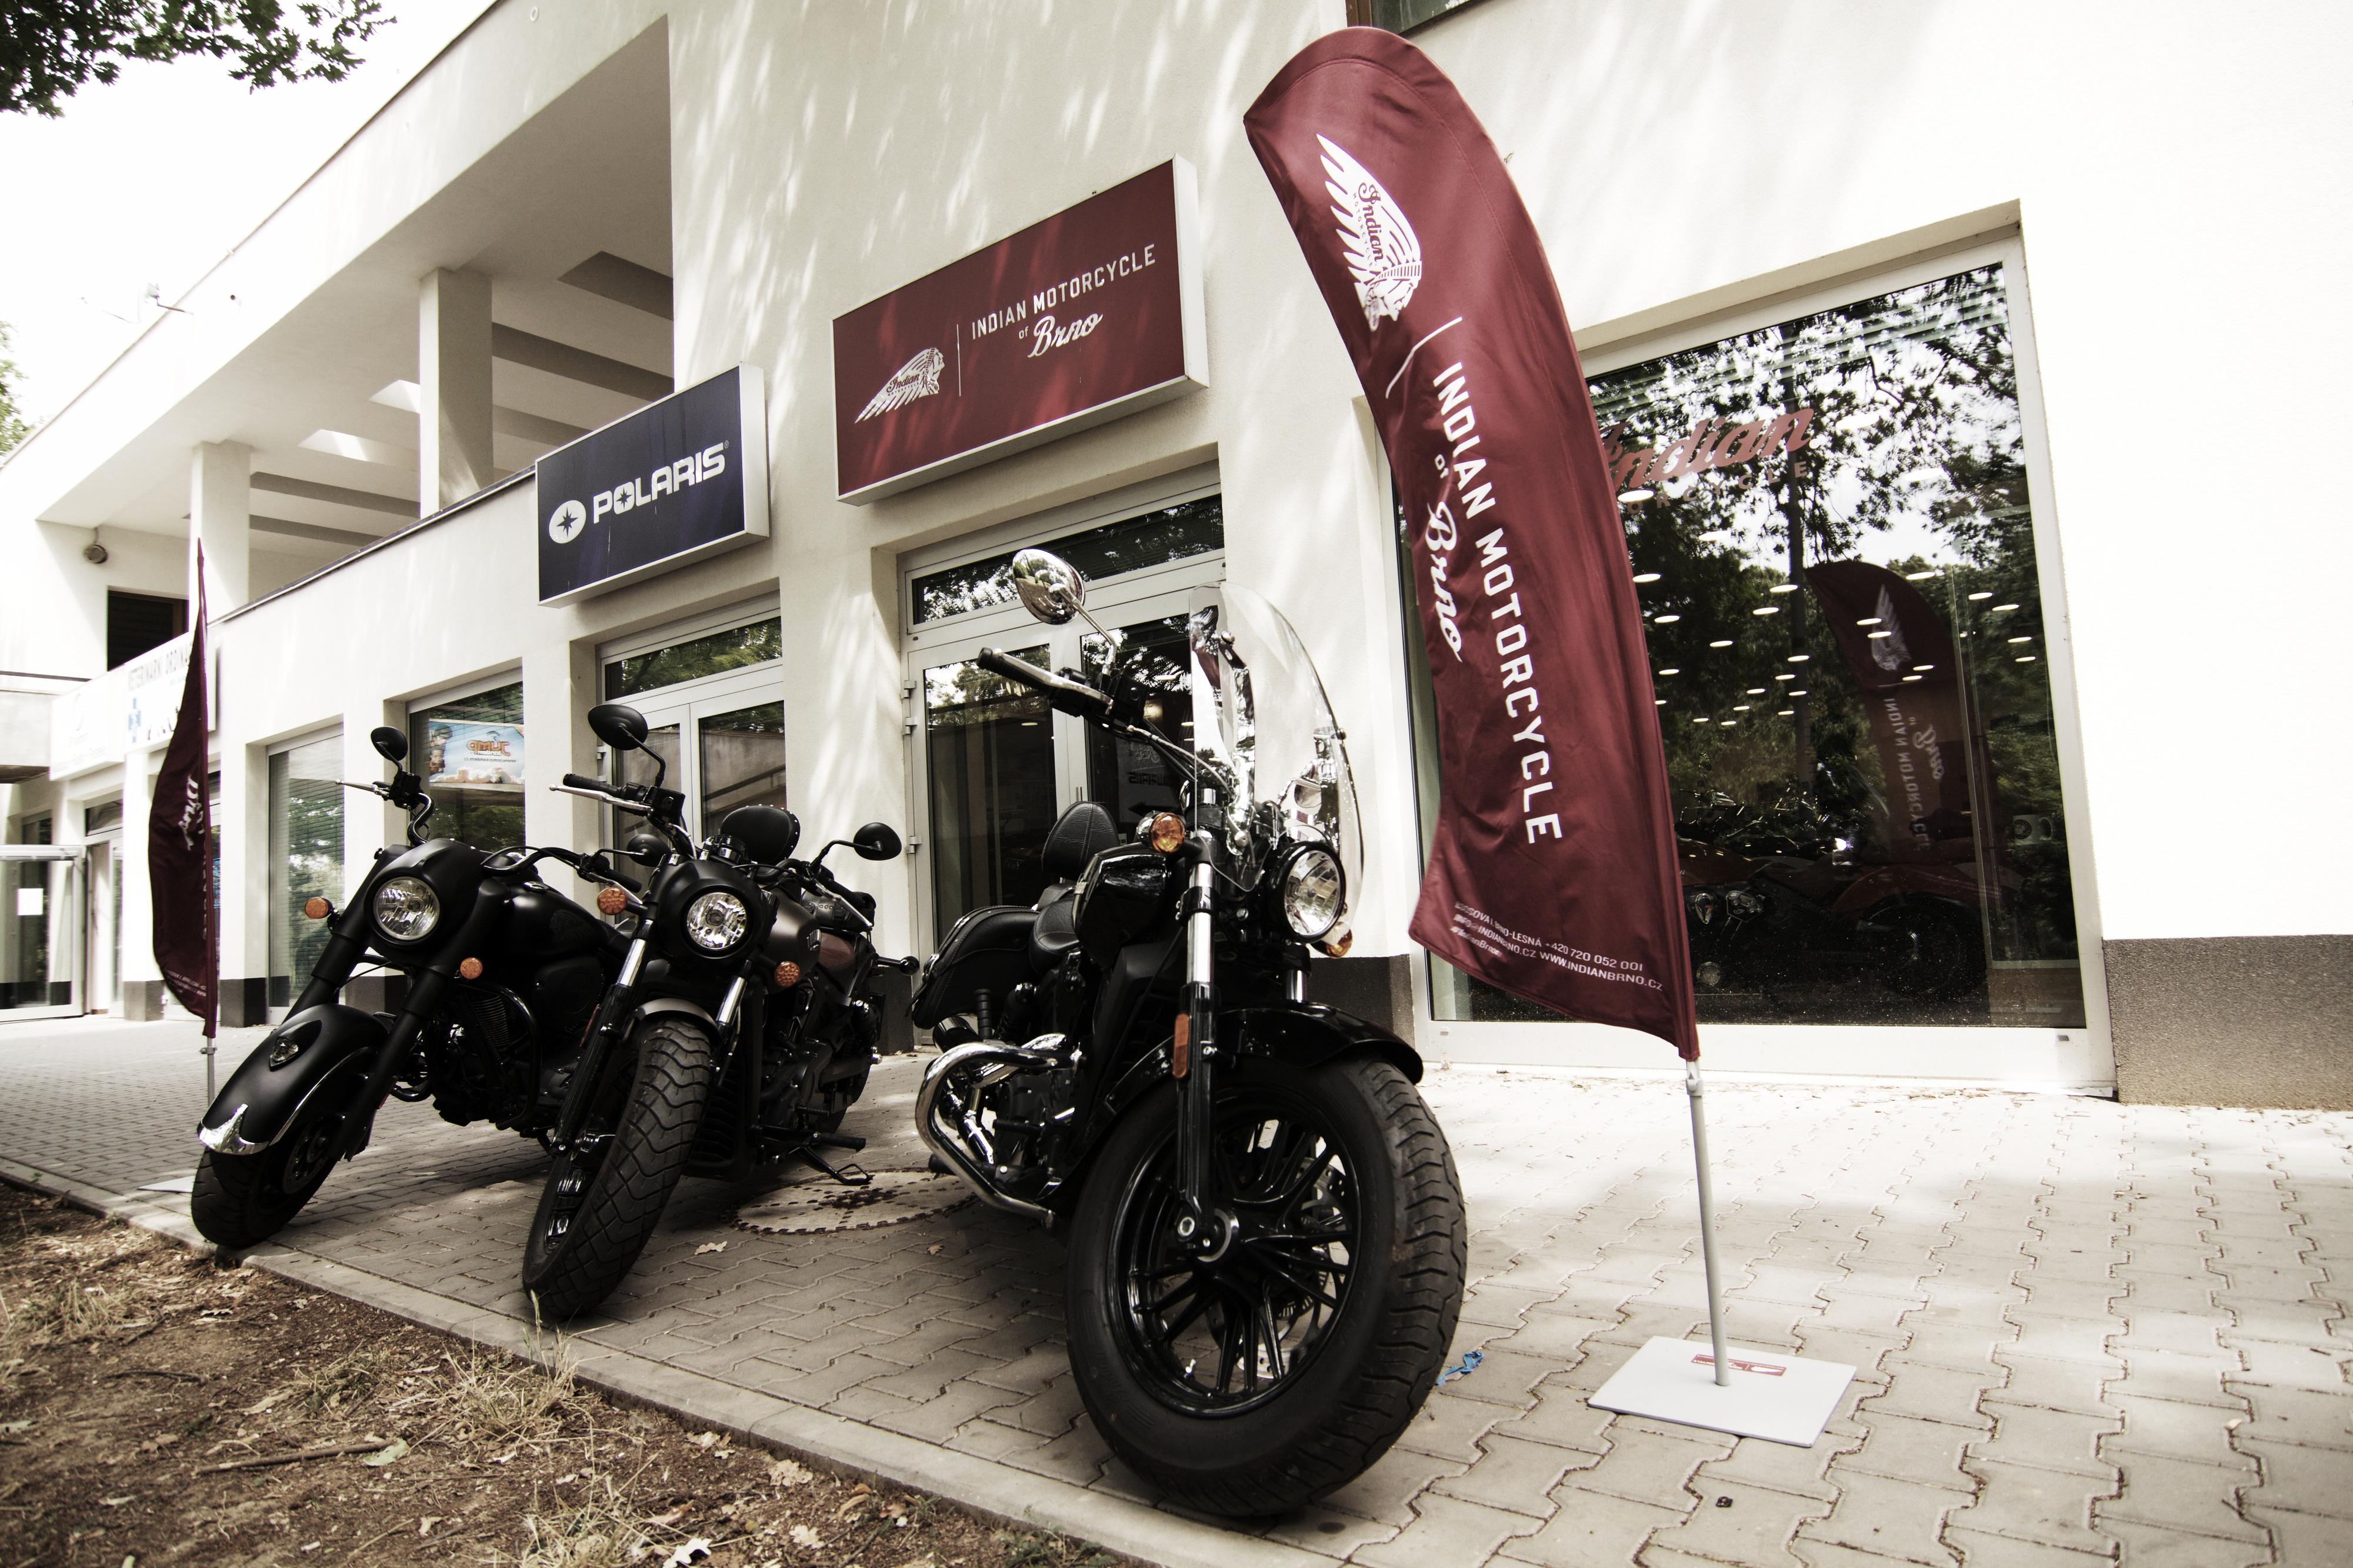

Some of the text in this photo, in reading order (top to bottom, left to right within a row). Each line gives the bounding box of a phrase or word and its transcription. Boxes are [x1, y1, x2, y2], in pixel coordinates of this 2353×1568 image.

[1358, 182, 1384, 262] Indian
[972, 243, 1155, 340] INDIAN MOTORCYCLE
[1027, 313, 1104, 358] Brno
[886, 373, 920, 393] Indian
[593, 442, 725, 525] POLARIS
[1627, 461, 1808, 514] ORCYCLE
[1425, 501, 1462, 663] Brno
[1433, 362, 1562, 844] INDIAN MOTORCYCLE
[1545, 942, 1568, 955] +420
[1570, 948, 1591, 962] 720
[1594, 955, 1618, 968] 052
